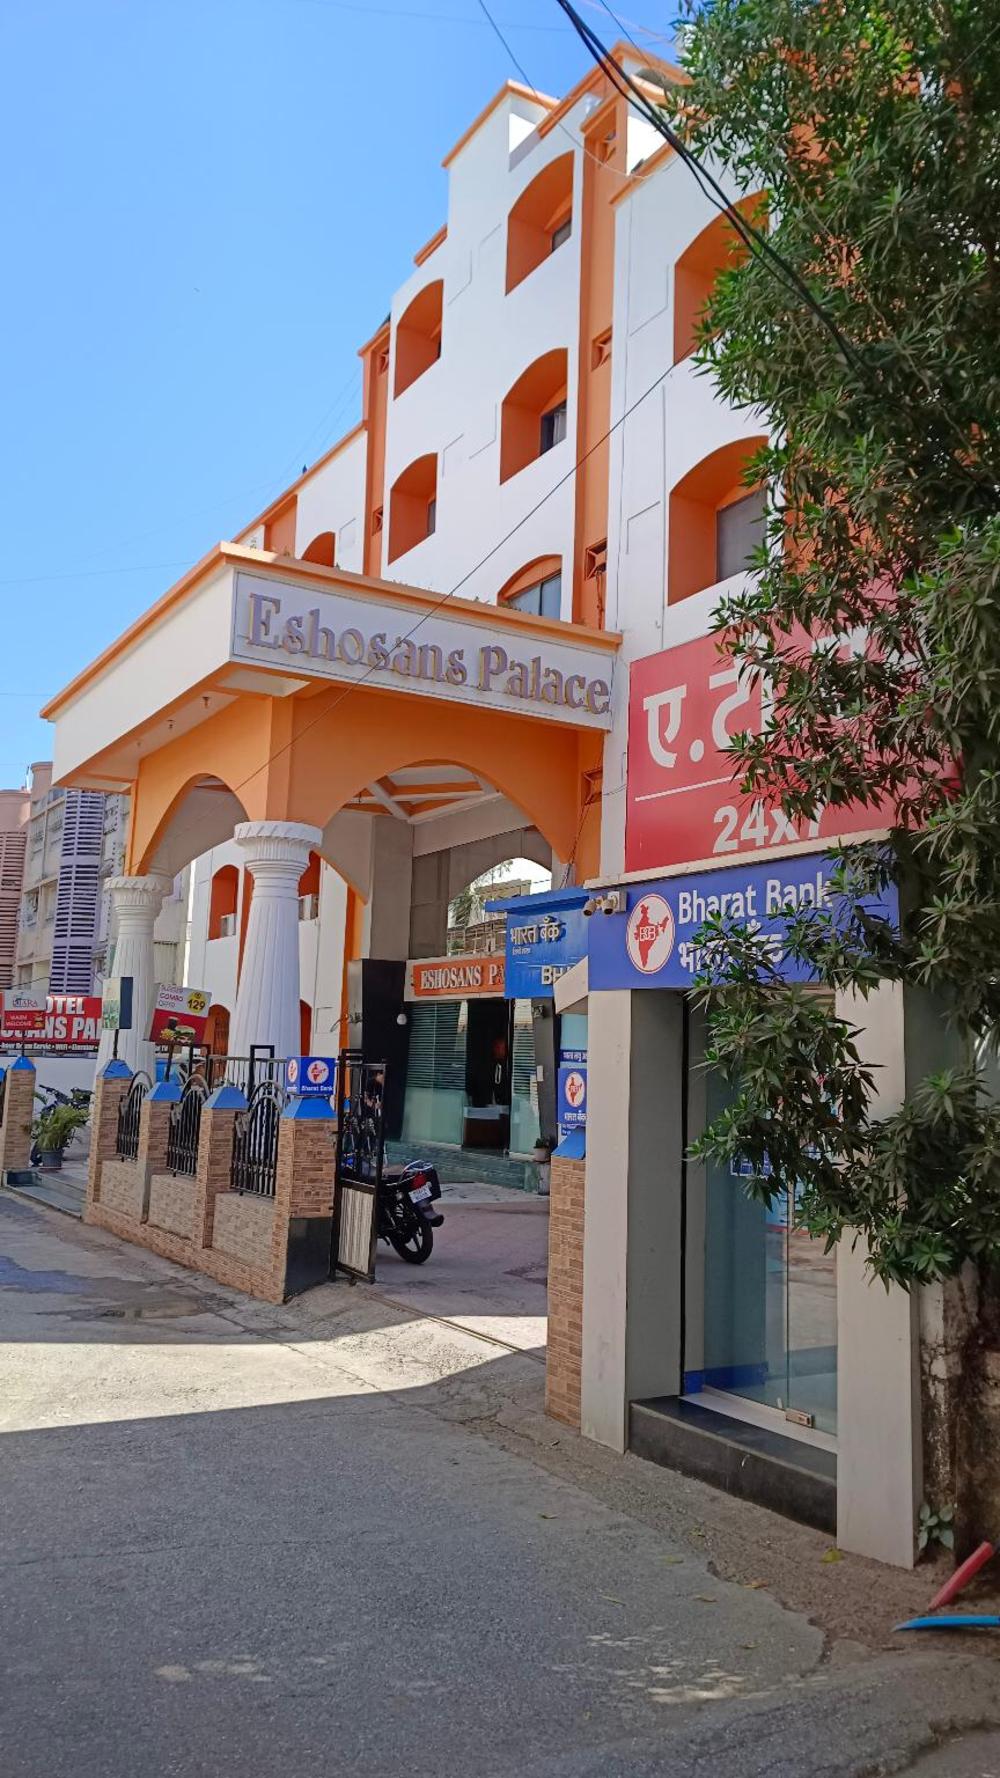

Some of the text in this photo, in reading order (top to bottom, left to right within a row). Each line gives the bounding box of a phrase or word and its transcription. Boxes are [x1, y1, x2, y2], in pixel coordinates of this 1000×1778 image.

[247, 592, 611, 716] Eshosans Palace
[677, 871, 834, 925] Bharat Bank
[510, 924, 538, 945] भारत
[421, 964, 482, 990] ESHOSANS
[187, 999, 206, 1010] 129
